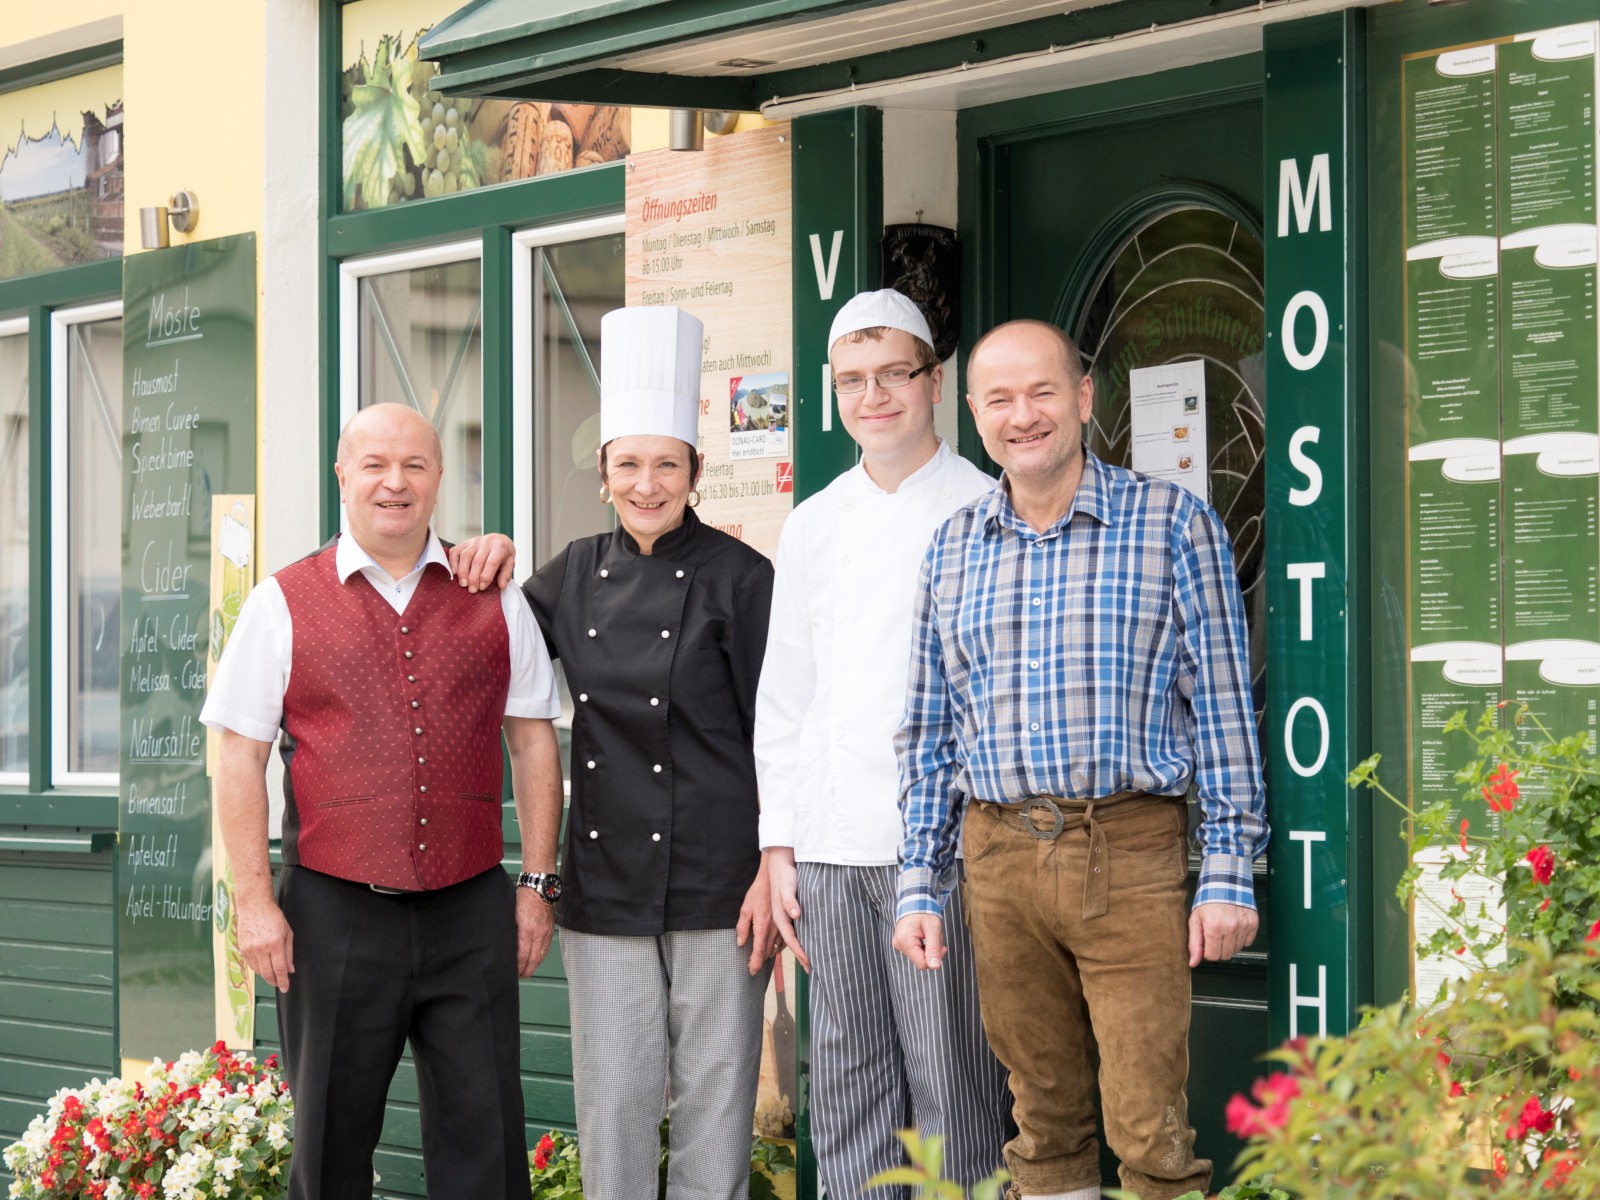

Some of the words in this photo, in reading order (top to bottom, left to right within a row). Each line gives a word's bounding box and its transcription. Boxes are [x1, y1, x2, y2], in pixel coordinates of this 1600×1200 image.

[642, 191, 717, 223] Öffnungszeiten
[642, 236, 667, 254] Montag
[672, 229, 702, 249] Dienstag
[708, 222, 740, 242] Mittwoch
[746, 219, 775, 237] Samstag
[642, 261, 650, 275] ab
[652, 257, 670, 274] 15.00
[671, 256, 683, 271] Uhr
[642, 289, 664, 306] Freitag
[670, 286, 690, 302] Sonn-
[691, 283, 704, 298] und
[705, 281, 733, 298] Feiertag
[718, 354, 735, 371] auch
[736, 350, 772, 370] Mittwoch)
[132, 359, 179, 397] Hausmost
[732, 435, 767, 446] DONAU-CARD
[706, 462, 734, 479] Feiertag
[709, 485, 728, 499] 16.30
[729, 484, 739, 498] bis
[740, 481, 760, 497] 21.00
[761, 479, 774, 496] Uhr
[141, 540, 193, 593] Cider
[130, 616, 158, 661] Apfel
[170, 614, 199, 651] Cider
[129, 664, 170, 692] Melissa
[181, 659, 208, 689] Cider
[129, 715, 200, 758] Natursäfte
[128, 782, 186, 815] Birnensaft
[127, 834, 178, 875] Apfelsaft
